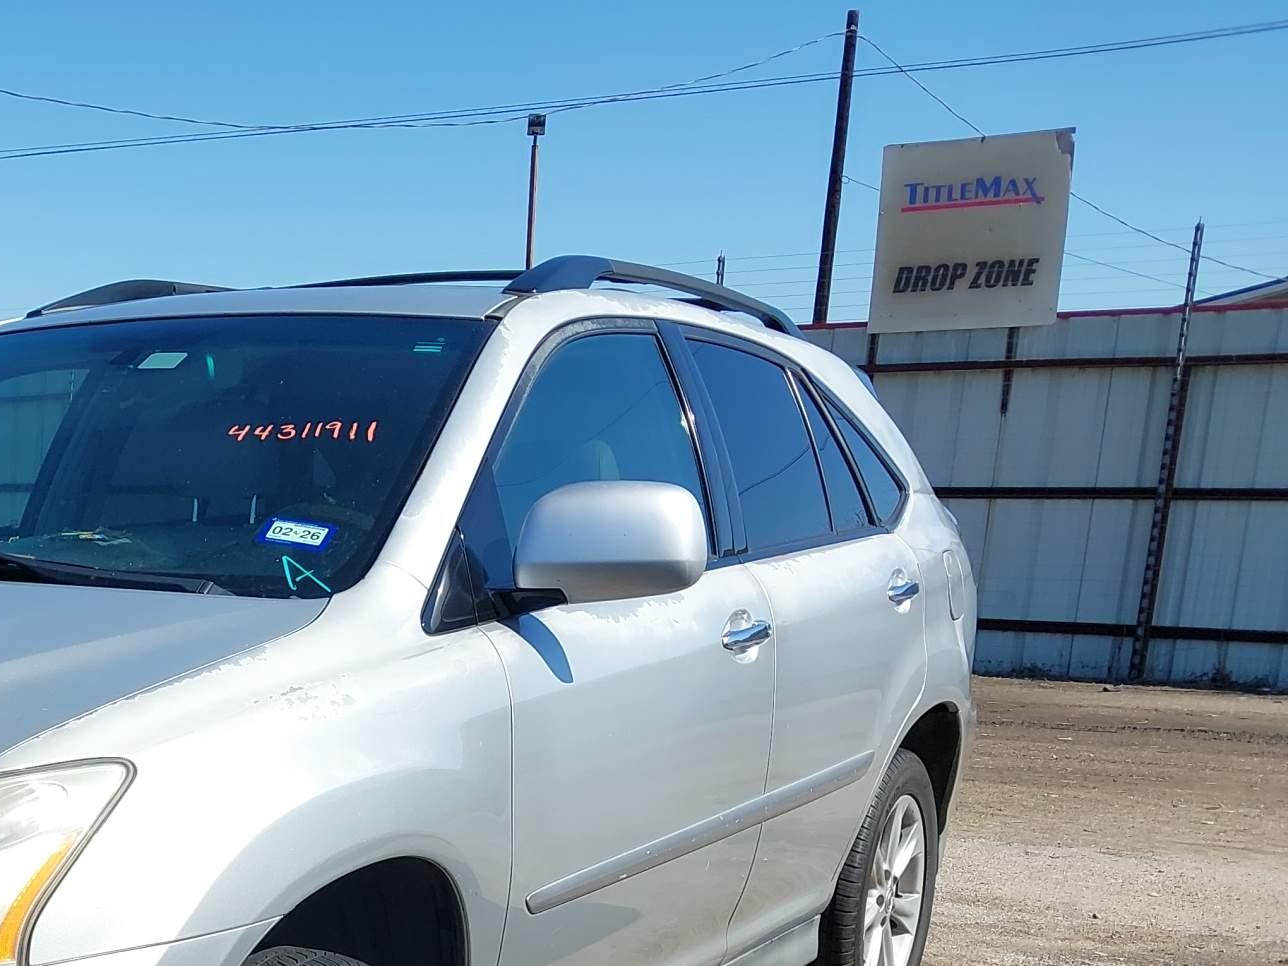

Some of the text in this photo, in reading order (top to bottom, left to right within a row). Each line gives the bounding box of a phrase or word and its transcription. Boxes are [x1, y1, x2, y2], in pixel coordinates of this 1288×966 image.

[892, 258, 1040, 294] DROP ZONE
[228, 421, 377, 442] 44311911
